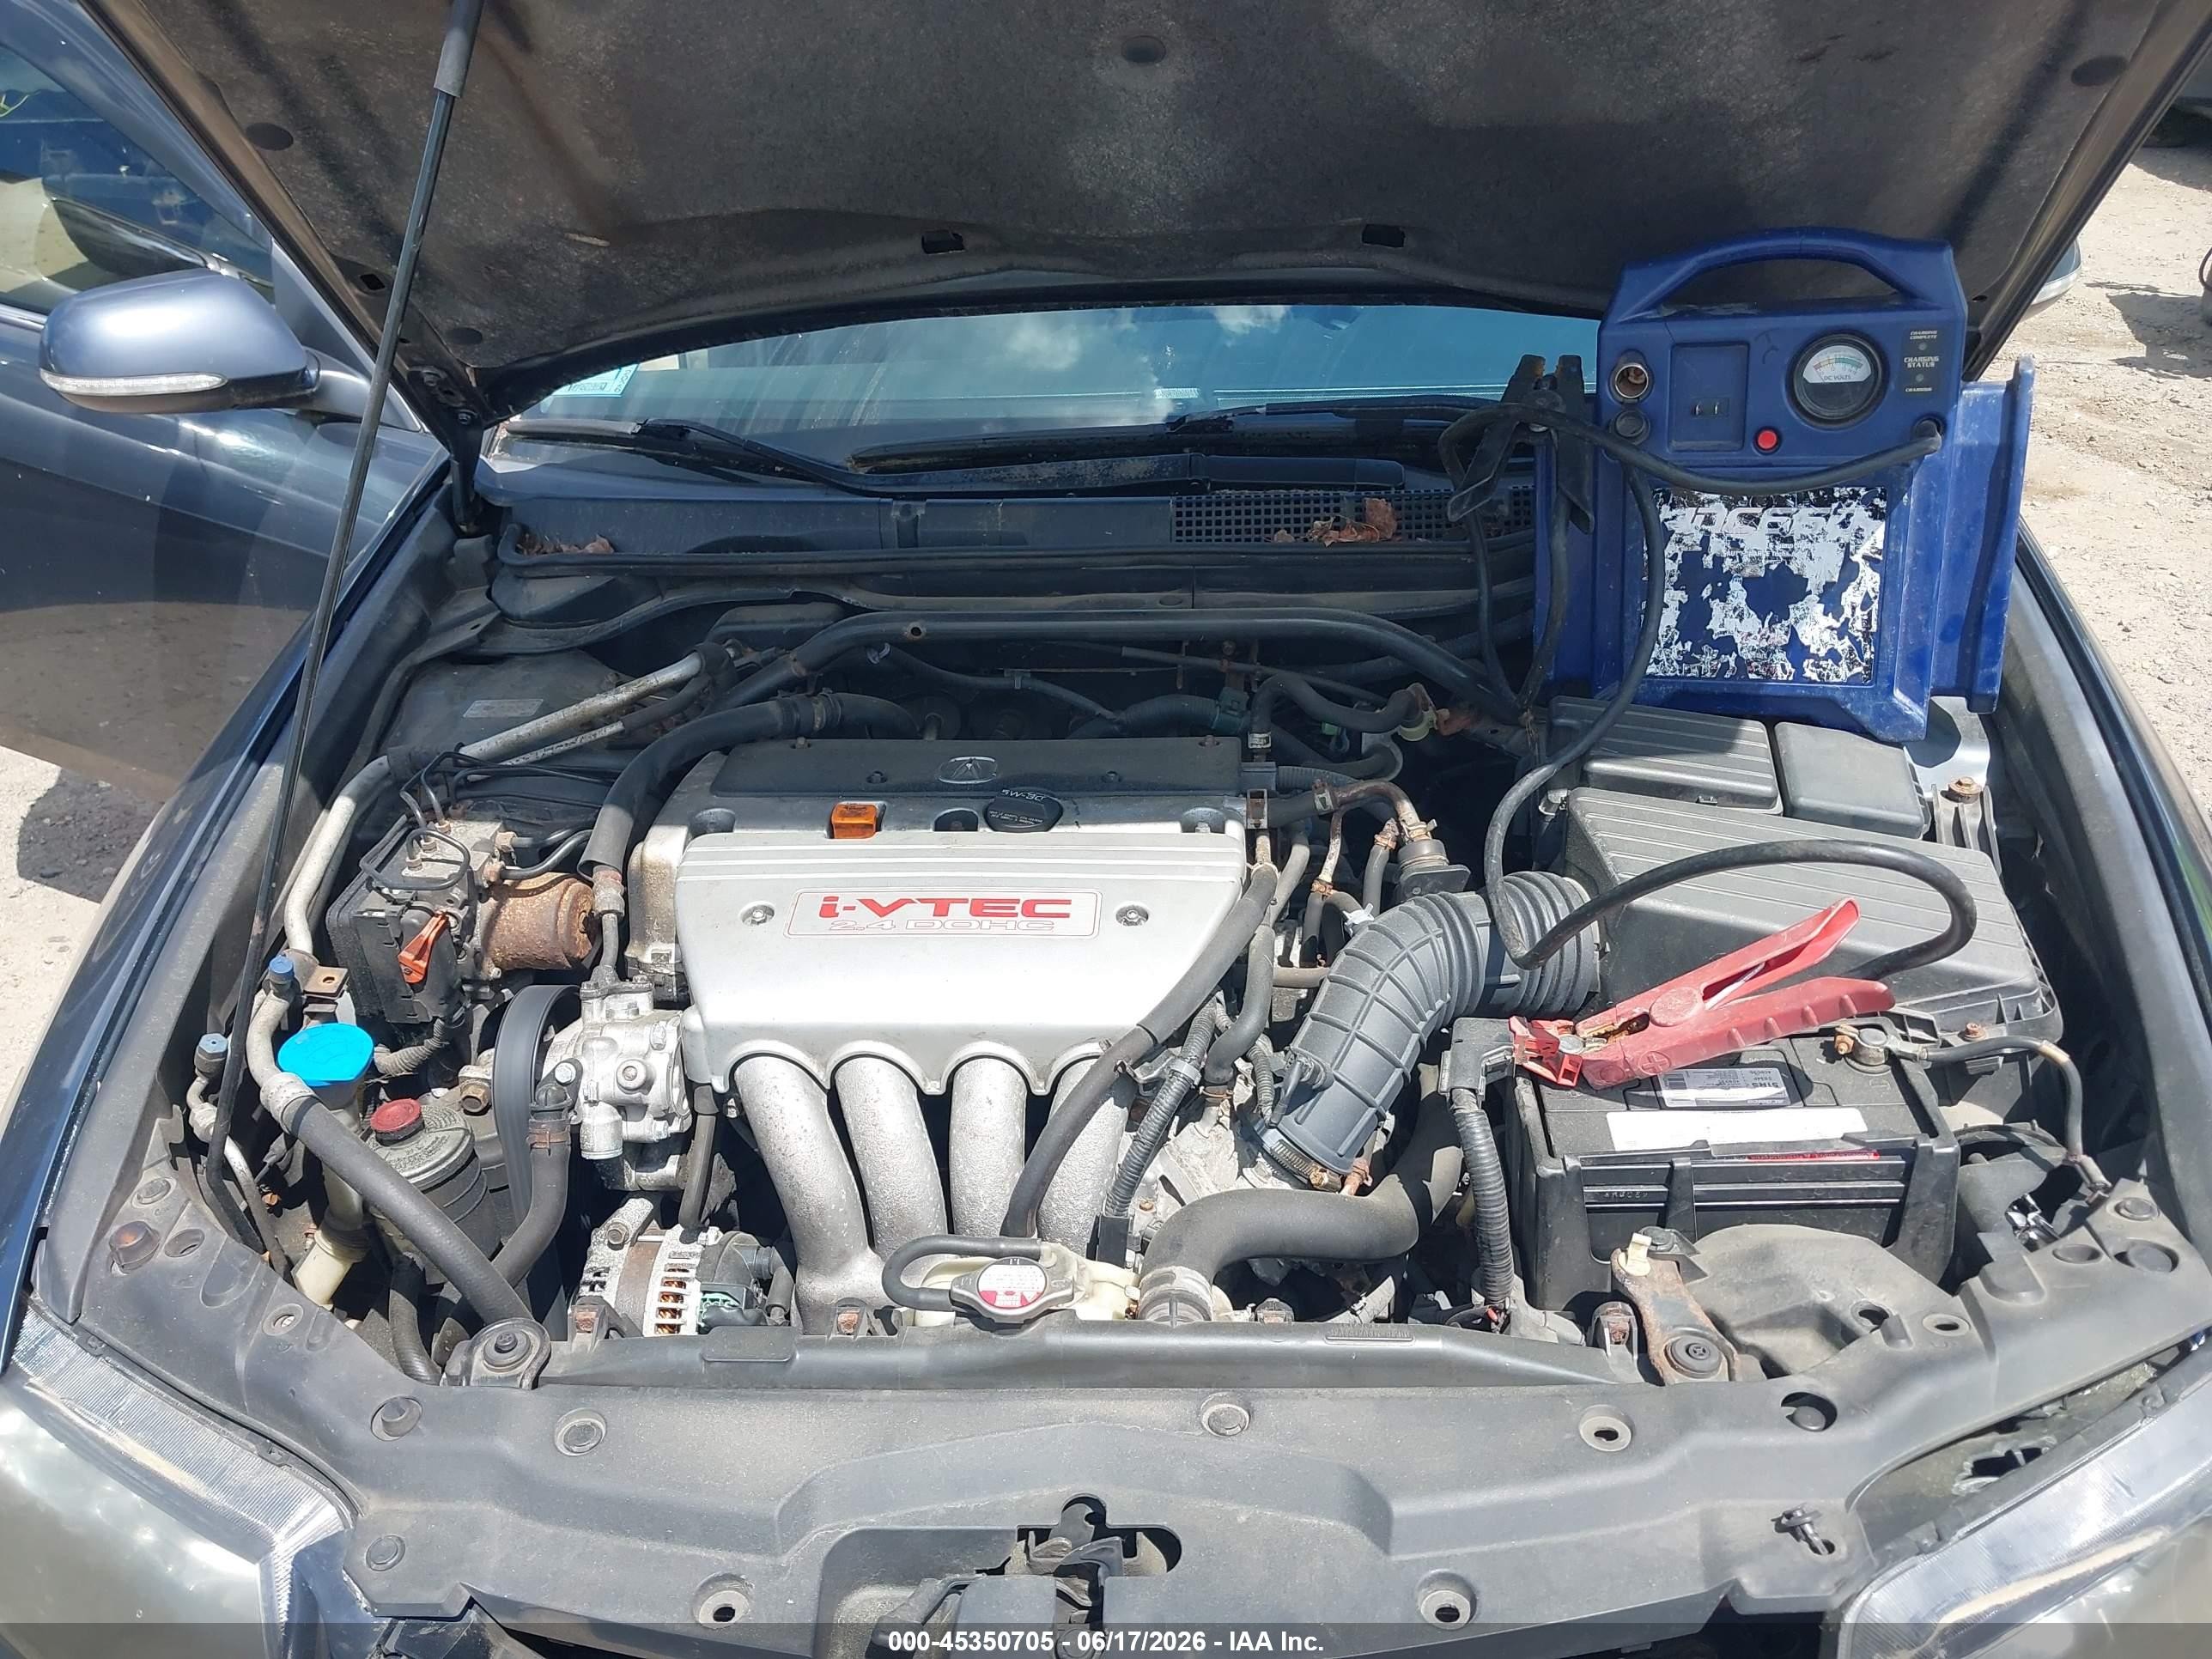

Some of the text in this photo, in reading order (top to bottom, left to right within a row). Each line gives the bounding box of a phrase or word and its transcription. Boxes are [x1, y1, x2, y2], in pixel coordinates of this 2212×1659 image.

[819, 896, 1073, 919] i-VTEC
[829, 919, 1055, 932] 2.4 DOHC
